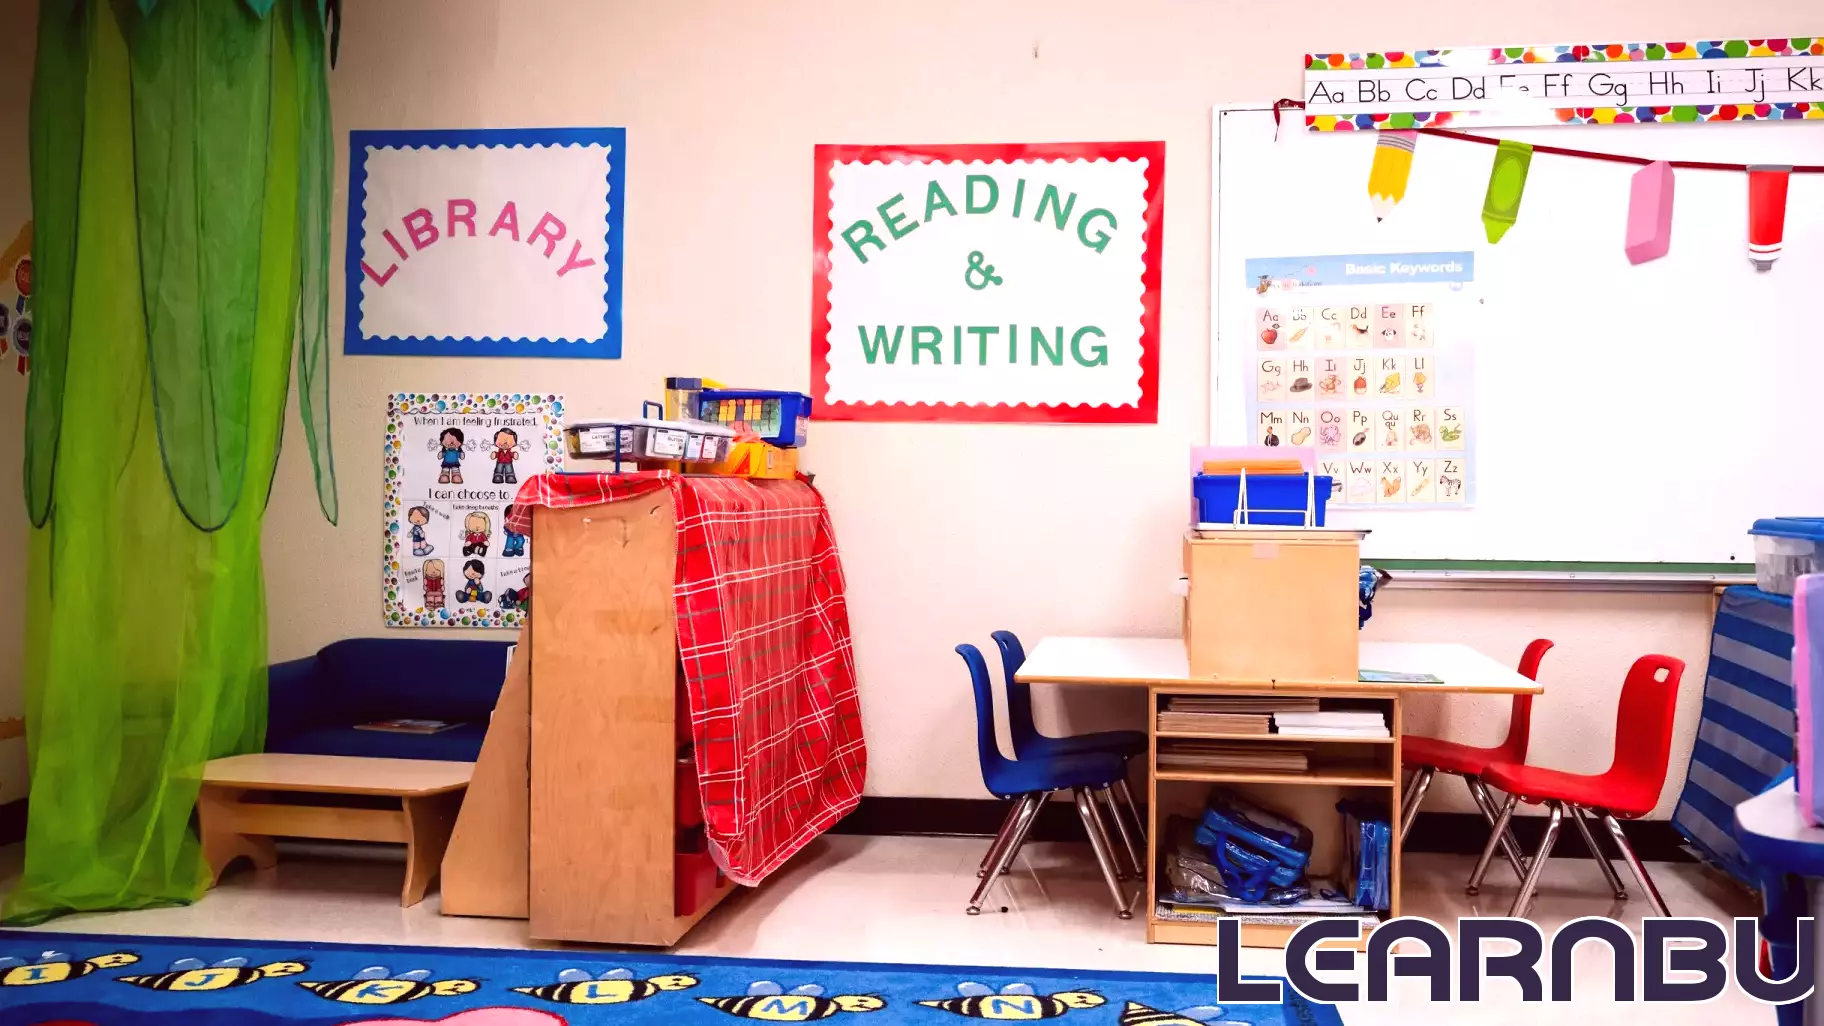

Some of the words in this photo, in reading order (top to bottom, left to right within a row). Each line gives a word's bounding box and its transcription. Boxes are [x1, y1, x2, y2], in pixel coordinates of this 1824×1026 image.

[1308, 81, 1344, 103] Aa
[1358, 79, 1390, 102] Bb
[1405, 78, 1437, 100] Cc
[1452, 76, 1485, 99] Dd
[1544, 73, 1573, 97] Ff
[1588, 72, 1628, 106] Gg
[1649, 71, 1683, 95] Hh
[1706, 70, 1720, 93] Ii
[1745, 68, 1764, 102] Jj
[1787, 66, 1823, 91] Kk
[840, 174, 1118, 264] READING
[360, 198, 597, 287] LIBRARY
[965, 250, 1003, 291] &
[1345, 262, 1386, 276] Basic
[1390, 260, 1463, 275] Keywords
[1263, 309, 1279, 321] Aa
[1321, 307, 1337, 320] Cc
[1350, 307, 1367, 320] Dd
[1381, 306, 1396, 319] Ee
[1411, 305, 1426, 318] Ff
[857, 323, 1108, 367] WRITING
[1261, 360, 1281, 376] Gg
[1292, 359, 1309, 372] Hh
[1324, 359, 1337, 371] Ii
[1353, 358, 1366, 374] Jj
[1382, 358, 1397, 371] Kk
[1414, 357, 1425, 370] Ll
[414, 416, 438, 426] When
[447, 417, 461, 426] am
[462, 416, 492, 428] feeling
[1260, 411, 1283, 424] Mm
[1292, 411, 1309, 424] Nn
[1320, 411, 1341, 423] Oo
[1352, 410, 1368, 426] Pp
[1382, 410, 1399, 421] Qu
[1413, 409, 1426, 421] Rr
[1443, 409, 1457, 421] Ss
[1322, 462, 1339, 474] Vv
[1349, 462, 1372, 474] Ww
[1382, 461, 1399, 474] Xx
[1413, 461, 1428, 476] Yy
[1444, 460, 1458, 473] Zz
[428, 488, 432, 499] I
[434, 490, 455, 500] can
[457, 488, 496, 500] choose
[24, 968, 44, 982] I
[186, 970, 218, 988] J
[355, 979, 404, 999] K
[587, 984, 619, 999] L
[763, 998, 810, 1017] M
[992, 1000, 1035, 1017] N
